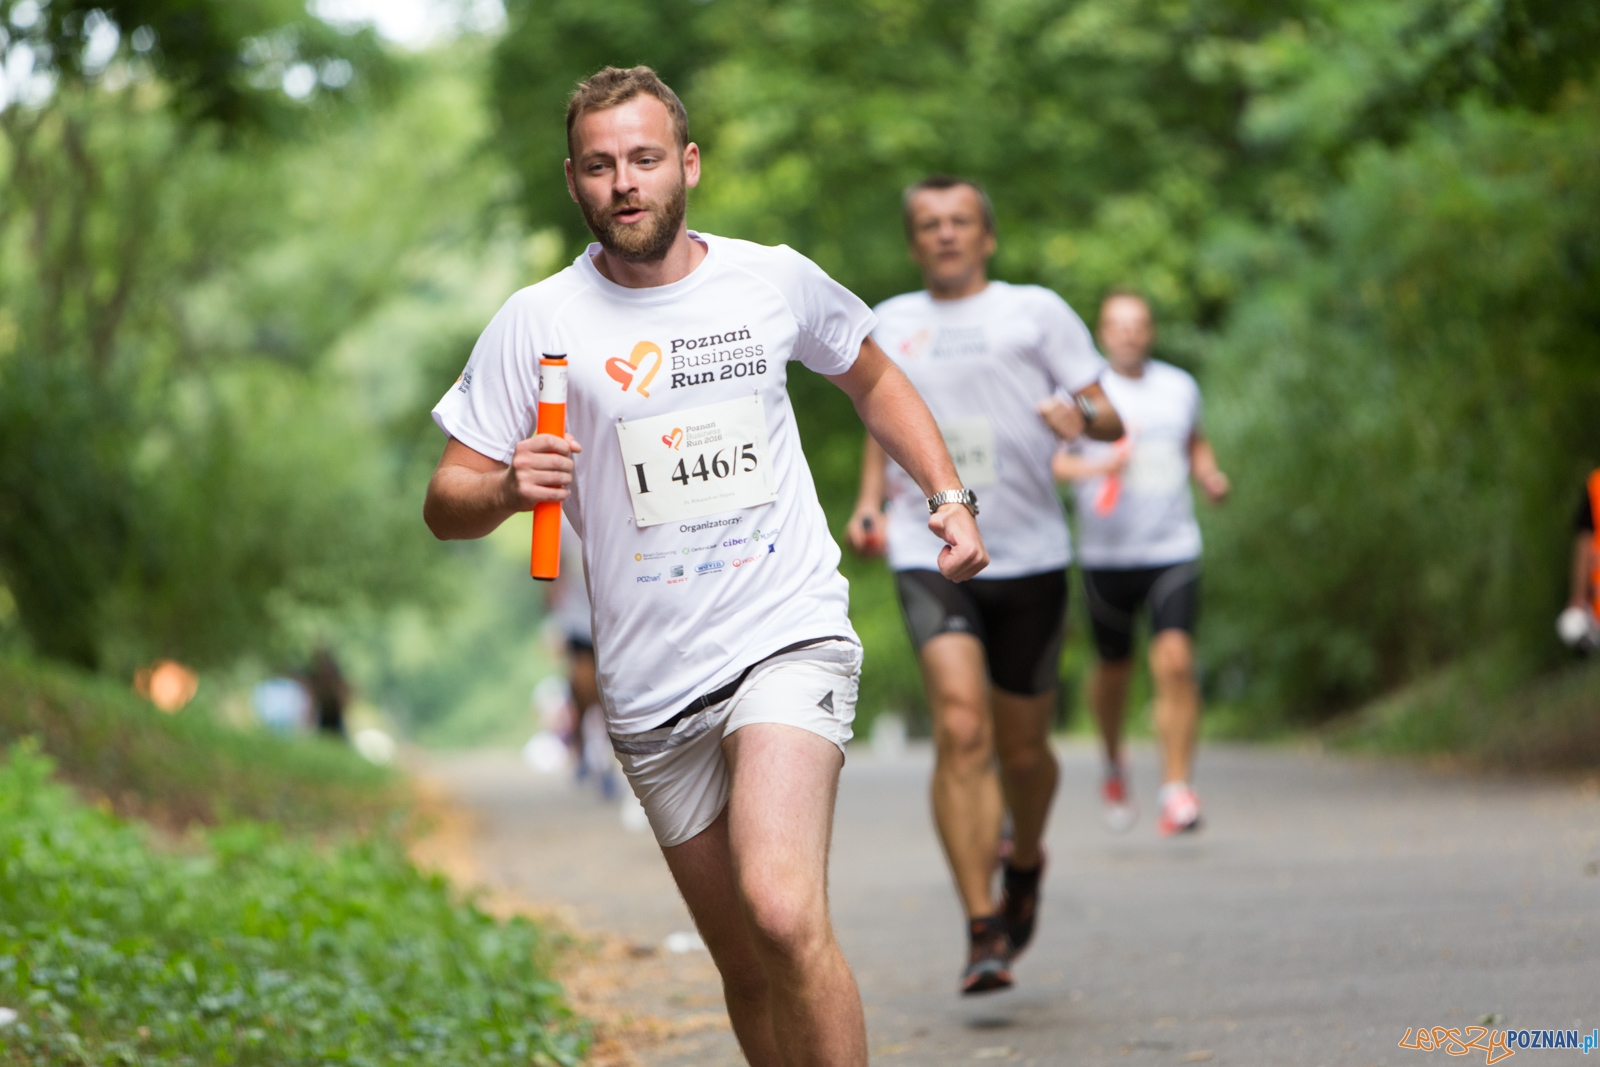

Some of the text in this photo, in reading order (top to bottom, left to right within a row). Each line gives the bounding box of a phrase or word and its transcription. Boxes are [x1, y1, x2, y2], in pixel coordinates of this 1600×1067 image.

[670, 325, 752, 354] Poznań
[671, 344, 764, 371] Business
[670, 359, 768, 390] Run 2016
[686, 420, 716, 433] Poznań
[686, 428, 721, 440] Business
[686, 434, 723, 448] Run 2016
[671, 443, 758, 486] 446/5
[679, 516, 743, 533] Organizatorzy:
[722, 537, 748, 548] ciber
